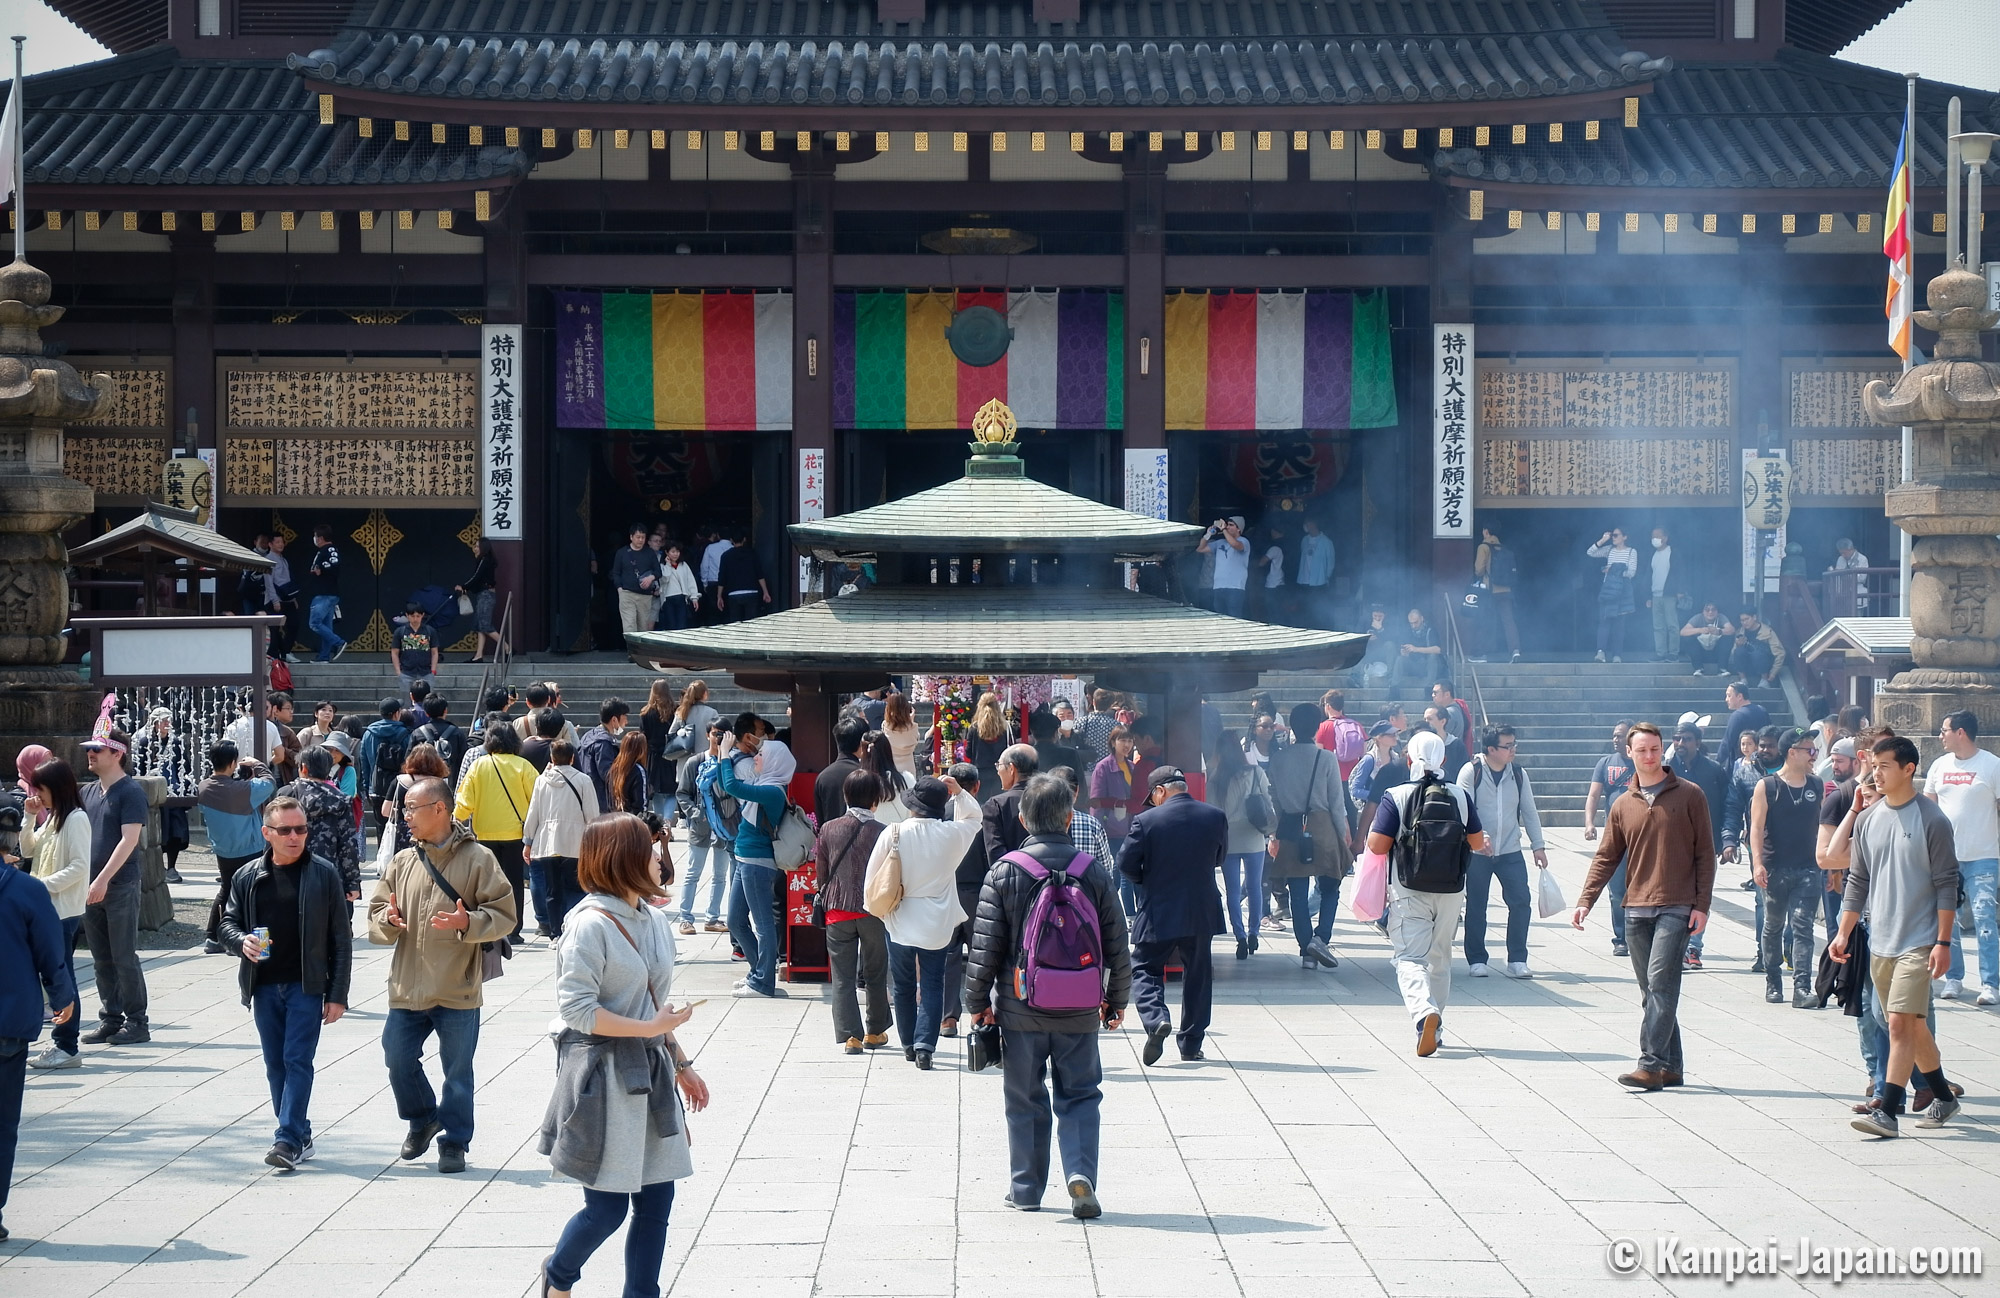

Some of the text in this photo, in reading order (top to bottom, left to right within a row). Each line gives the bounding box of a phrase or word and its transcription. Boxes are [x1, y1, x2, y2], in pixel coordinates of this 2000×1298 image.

[584, 323, 595, 398] 平成二十六年五月
[489, 334, 515, 531] 特別大護摩祈願芳名
[1441, 333, 1466, 529] 特別大護摩祈願芳名
[804, 453, 818, 522] 花まつ
[1763, 462, 1784, 525] 弘法大師
